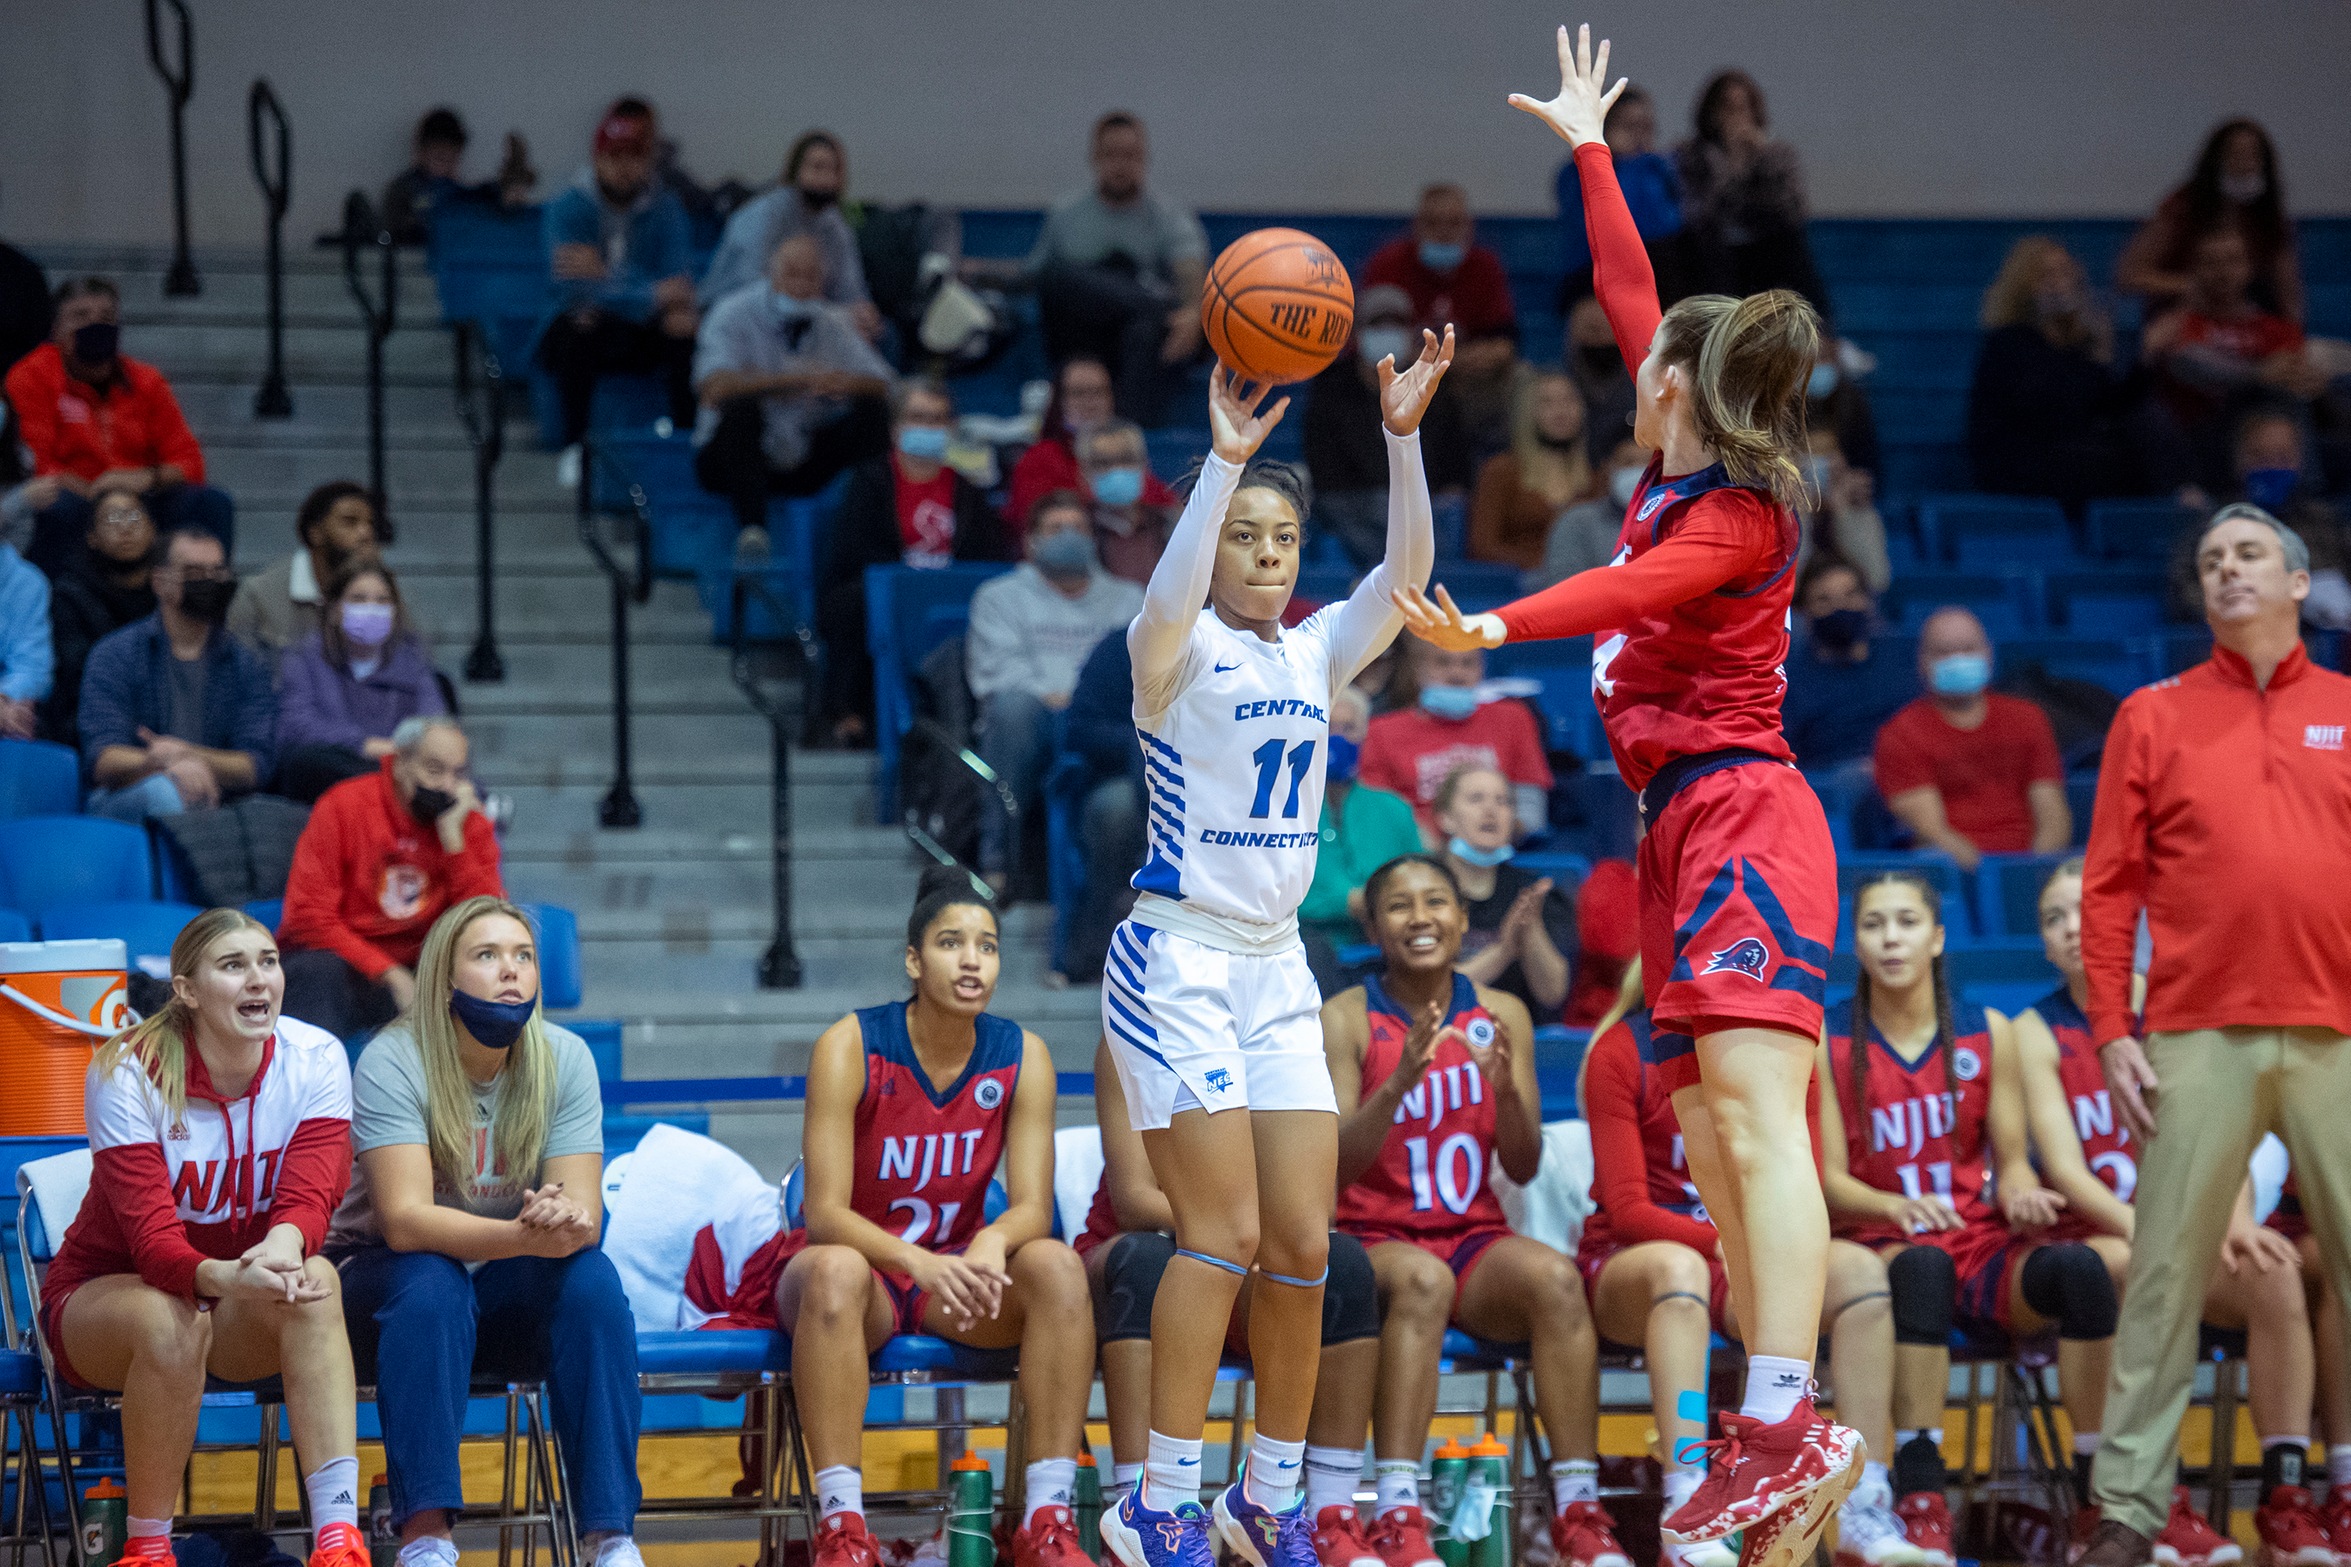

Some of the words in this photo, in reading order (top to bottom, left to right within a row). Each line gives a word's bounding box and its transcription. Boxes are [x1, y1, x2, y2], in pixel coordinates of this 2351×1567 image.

[1270, 303, 1317, 340] THE
[1234, 699, 1327, 724] CENTRAL
[1249, 738, 1316, 819] 11
[878, 1128, 984, 1193] NJIT
[1404, 1132, 1483, 1215] 10
